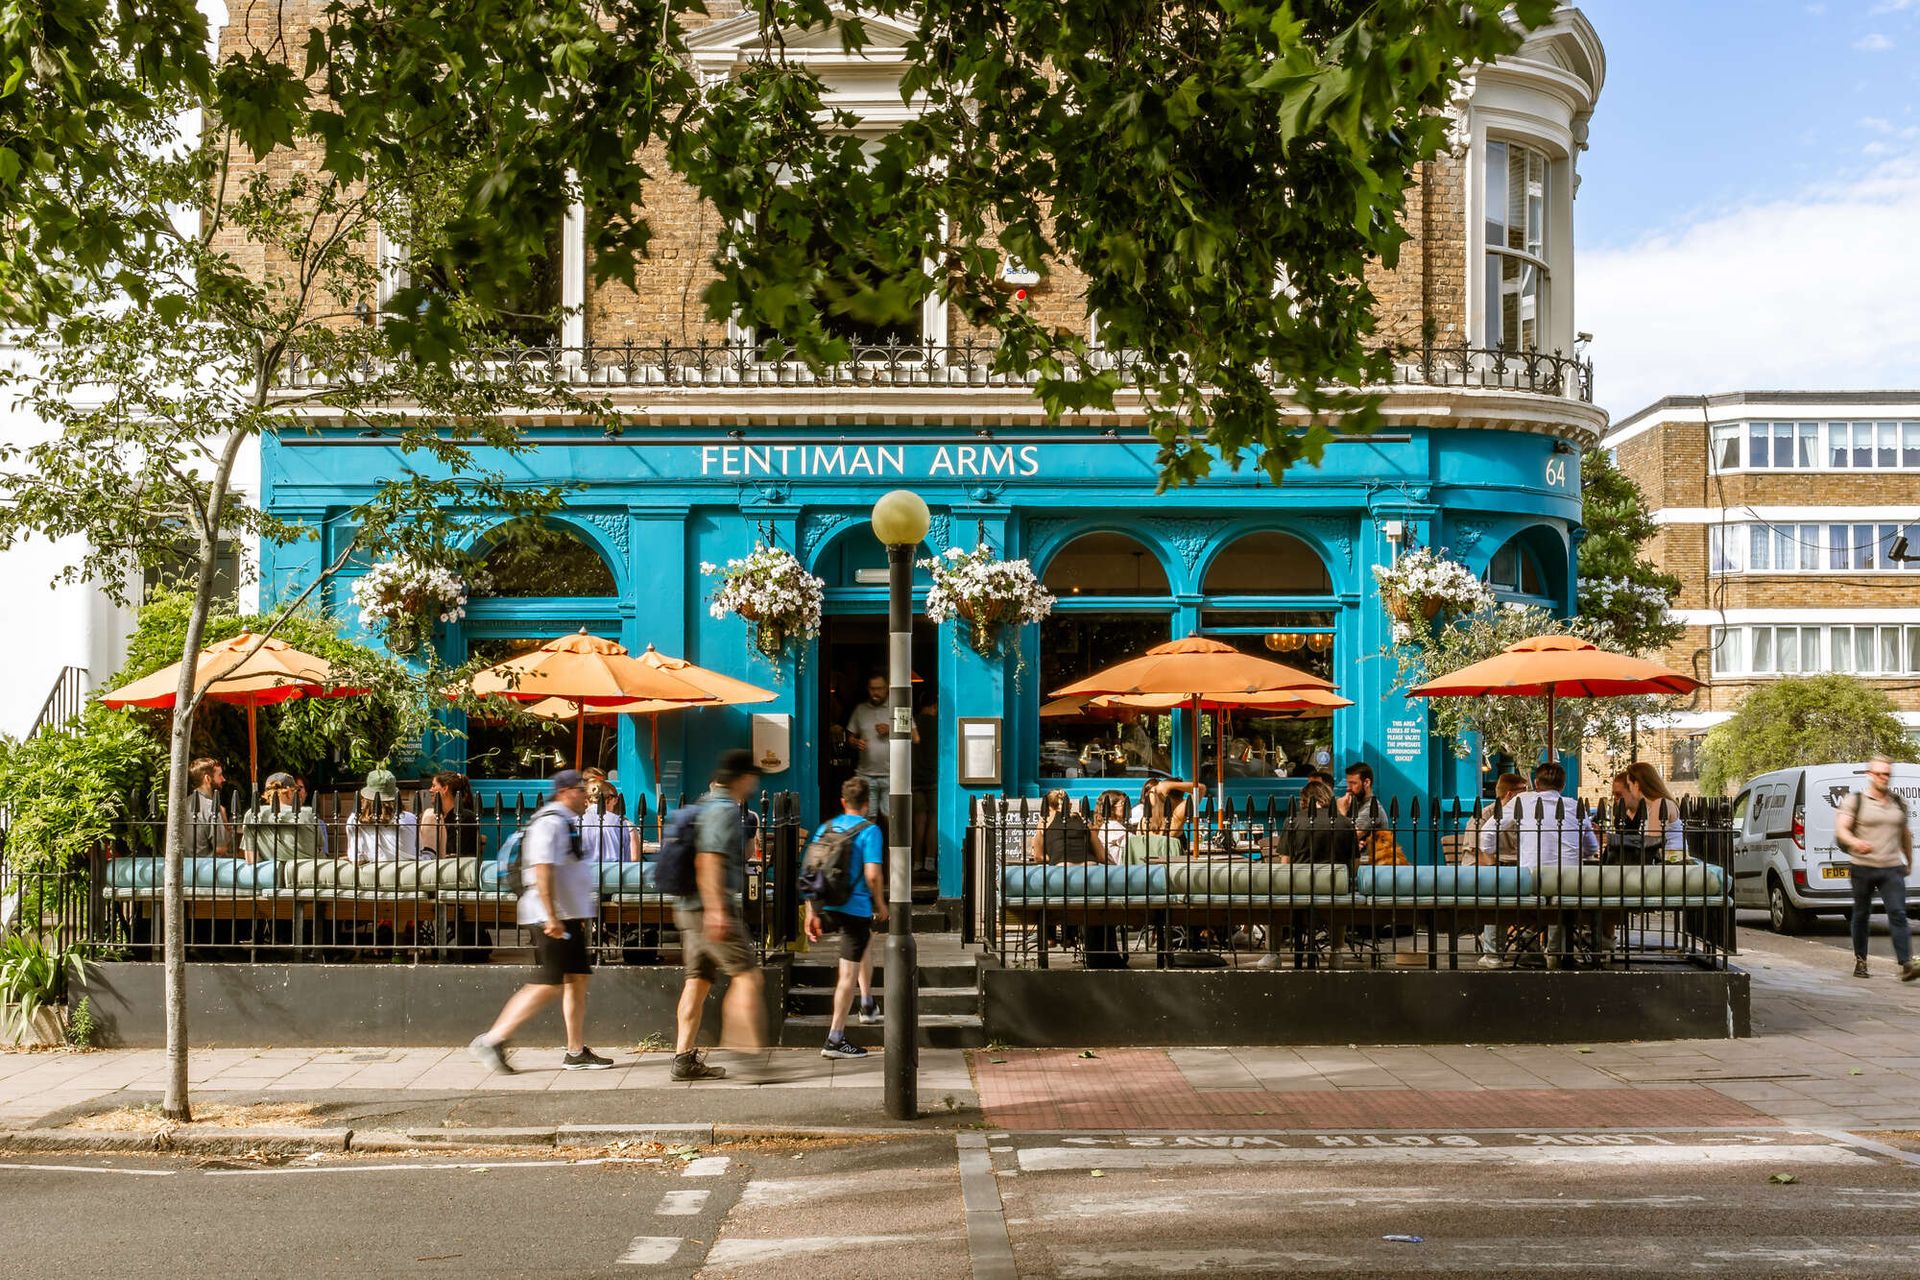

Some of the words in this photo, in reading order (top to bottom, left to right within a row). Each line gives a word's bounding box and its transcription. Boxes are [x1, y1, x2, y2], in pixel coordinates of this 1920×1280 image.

[702, 445, 904, 476] FENTIMAN
[929, 445, 1040, 477] ARMS
[1545, 458, 1566, 488] 64
[1125, 1136, 1290, 1148] WAYS
[1315, 1135, 1482, 1147] BOTH
[1515, 1133, 1676, 1146] LOOK
